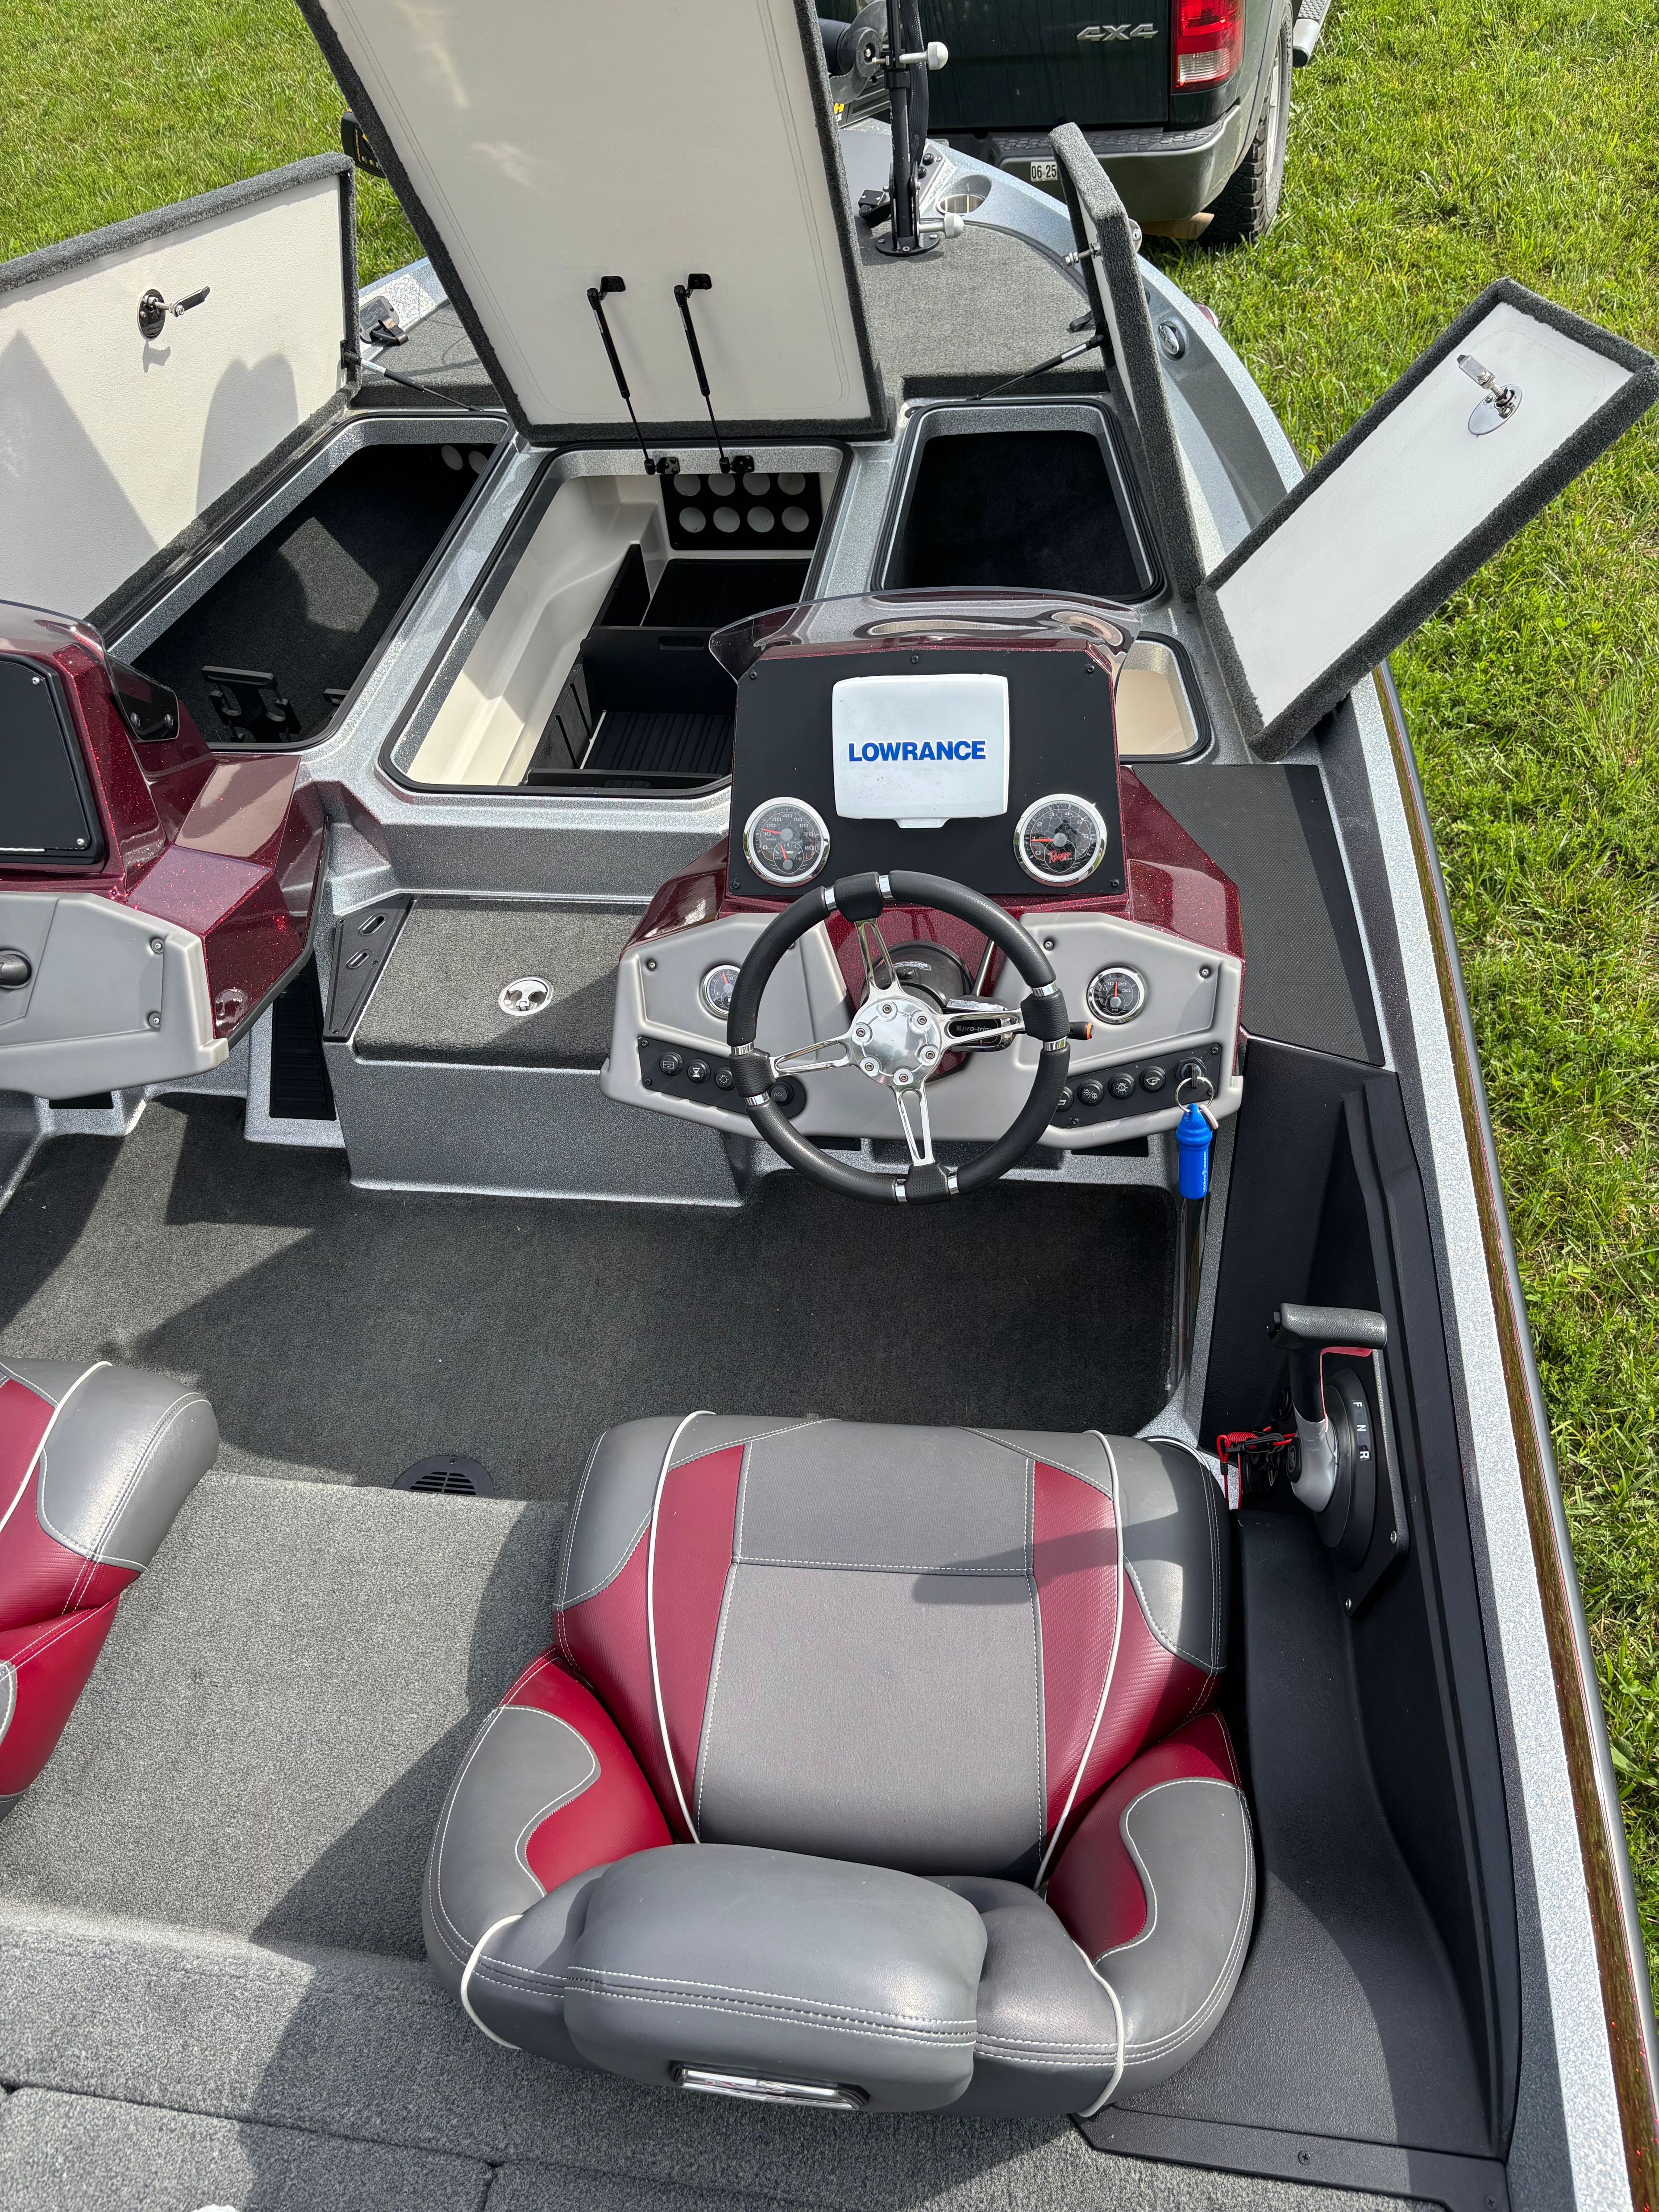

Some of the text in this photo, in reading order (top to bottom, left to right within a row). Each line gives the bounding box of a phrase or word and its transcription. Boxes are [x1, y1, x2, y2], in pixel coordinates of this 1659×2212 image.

[1032, 165, 1056, 179] 06 25
[849, 741, 986, 762] LOWRANCE
